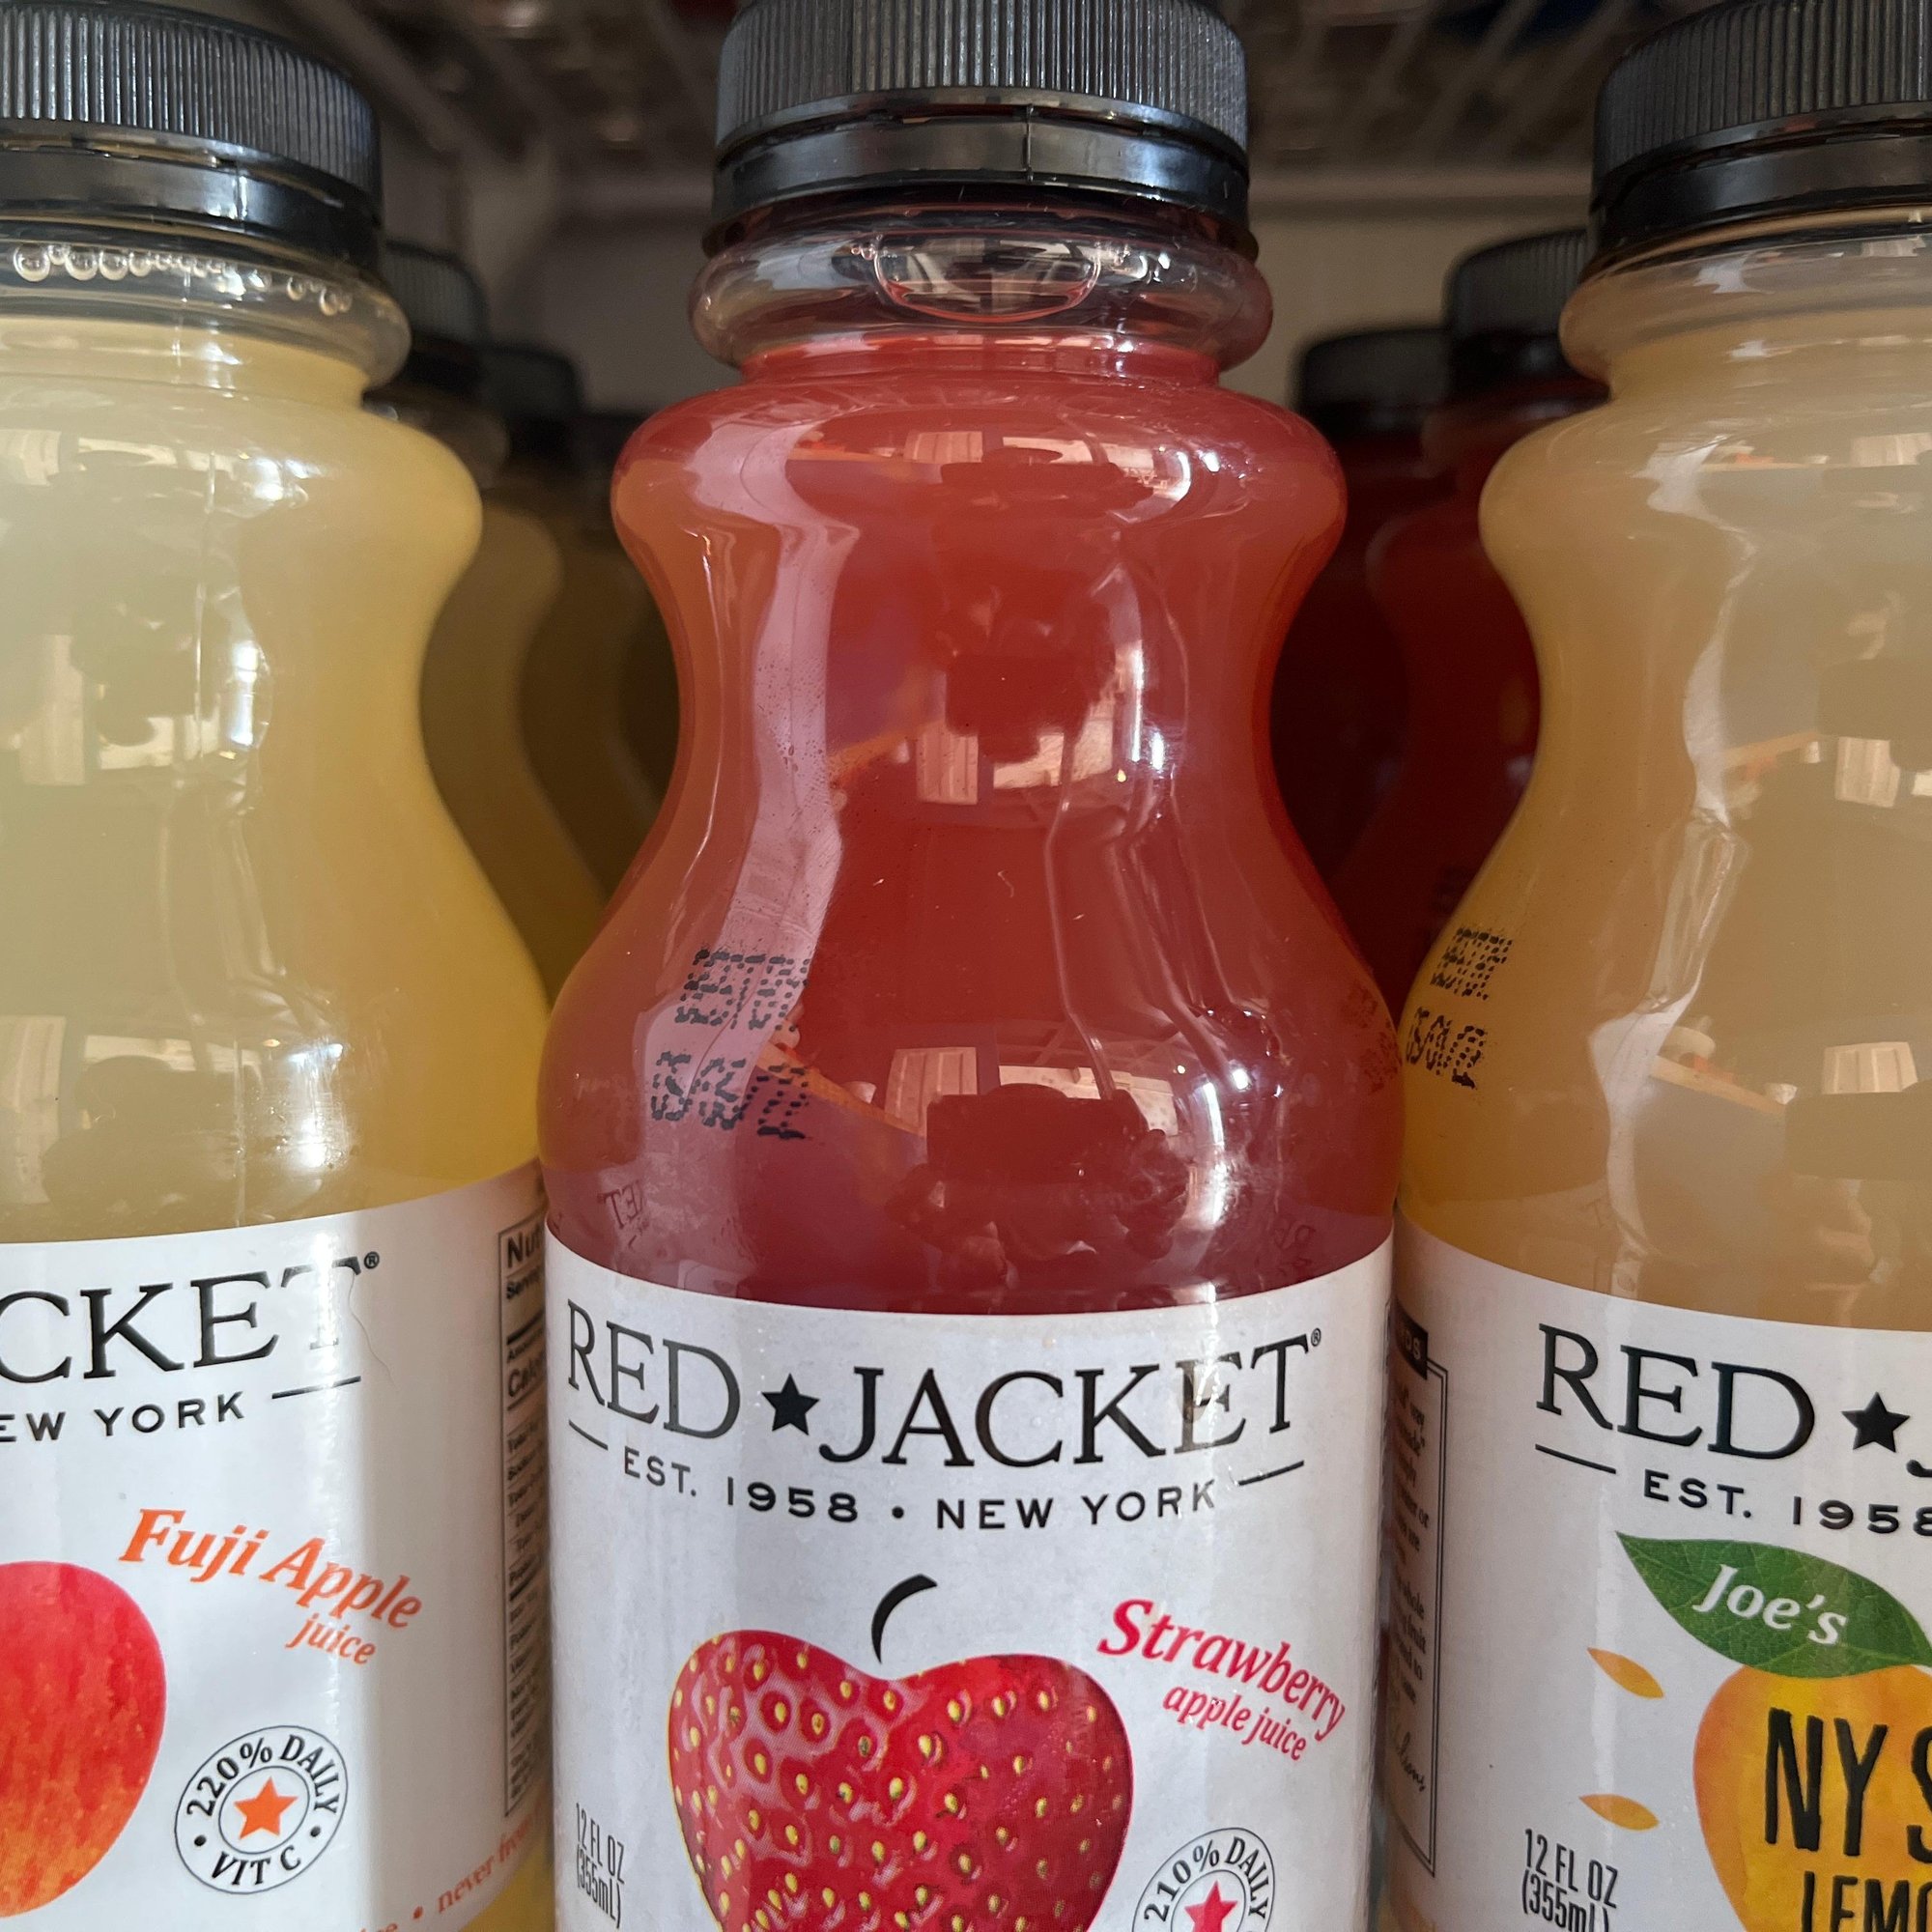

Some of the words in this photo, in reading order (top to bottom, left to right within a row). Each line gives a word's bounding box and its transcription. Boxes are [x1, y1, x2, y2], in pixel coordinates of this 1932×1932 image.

[568, 1298, 741, 1440] RED
[1536, 1322, 1815, 1461] RED
[94, 1391, 245, 1437] YORK
[624, 1446, 697, 1497] EST.
[726, 1475, 859, 1523] 1958
[937, 1497, 1054, 1529] NEW
[1081, 1478, 1216, 1525] YORK
[1643, 1468, 1751, 1520] EST.
[1793, 1495, 1932, 1537] 1958
[118, 1508, 270, 1582] Fuji
[259, 1537, 422, 1629] Apple
[1691, 1563, 1849, 1645] Joe's
[285, 1612, 377, 1665] juice
[1095, 1598, 1347, 1743] Strawberry
[1162, 1685, 1251, 1732] apple
[1241, 1706, 1307, 1761] juice
[185, 1737, 273, 1817] 220%
[279, 1734, 341, 1815] DAILY
[1765, 1707, 1889, 1857] NY
[211, 1850, 271, 1886] VIT
[279, 1844, 301, 1871] C
[576, 1802, 587, 1851] 12
[590, 1817, 604, 1867] FL
[608, 1834, 625, 1885] OZ
[1143, 1839, 1221, 1922] 210%
[1225, 1835, 1269, 1919] DAILY
[1524, 1828, 1548, 1877] 12
[1555, 1842, 1579, 1892] FL
[1587, 1859, 1619, 1909] OZ
[576, 1843, 621, 1929] (355mL)
